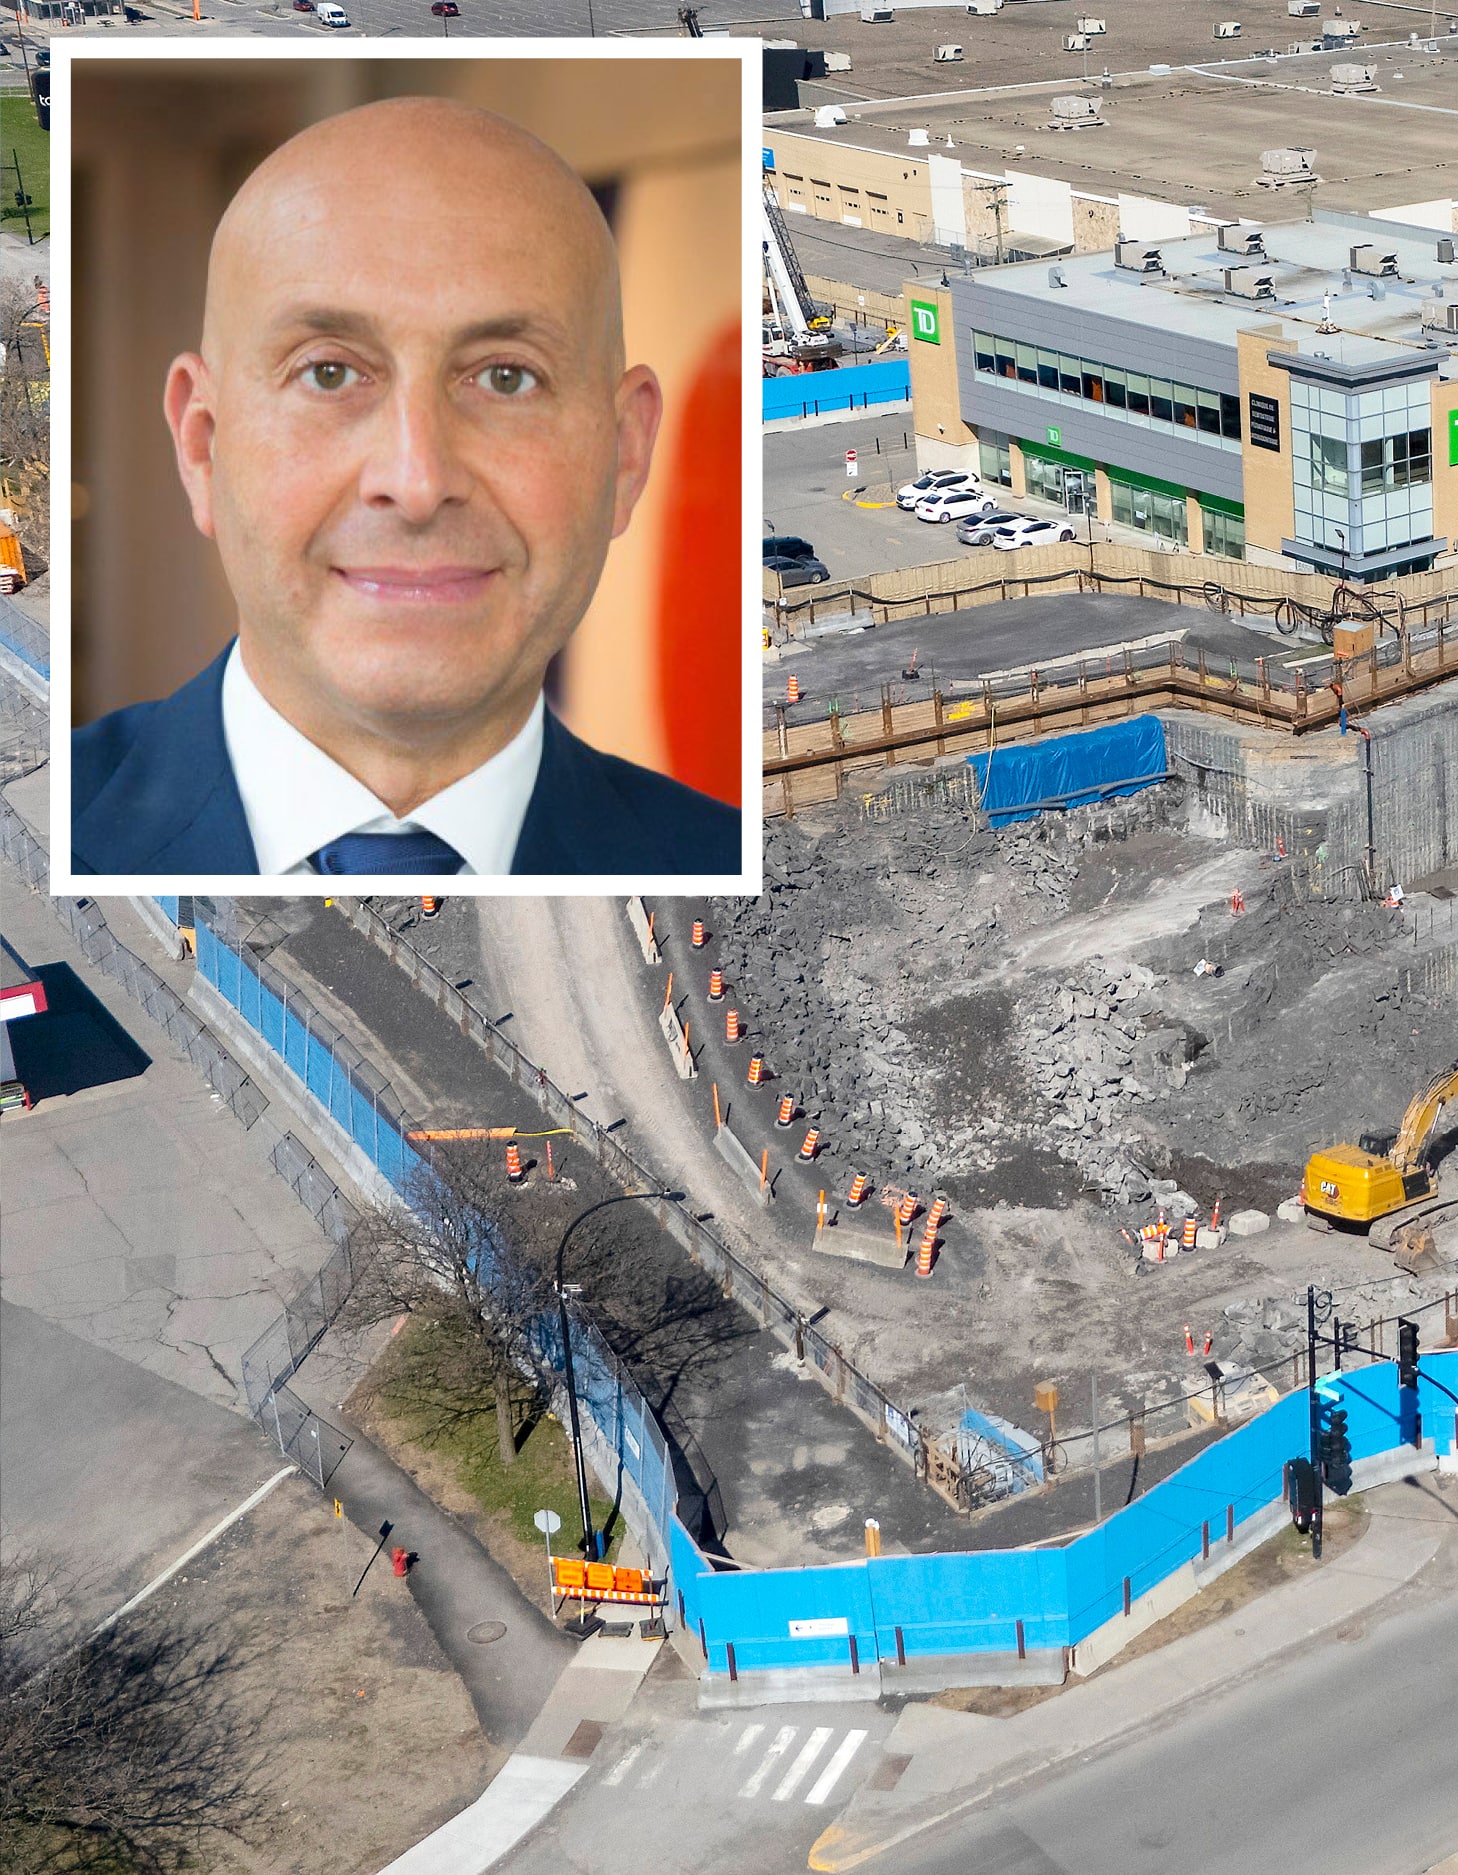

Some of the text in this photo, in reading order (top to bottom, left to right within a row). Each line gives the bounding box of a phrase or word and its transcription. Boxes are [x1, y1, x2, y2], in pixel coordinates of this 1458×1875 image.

[913, 307, 935, 334] TD
[1047, 428, 1059, 442] TD
[1320, 1181, 1336, 1196] CAT
